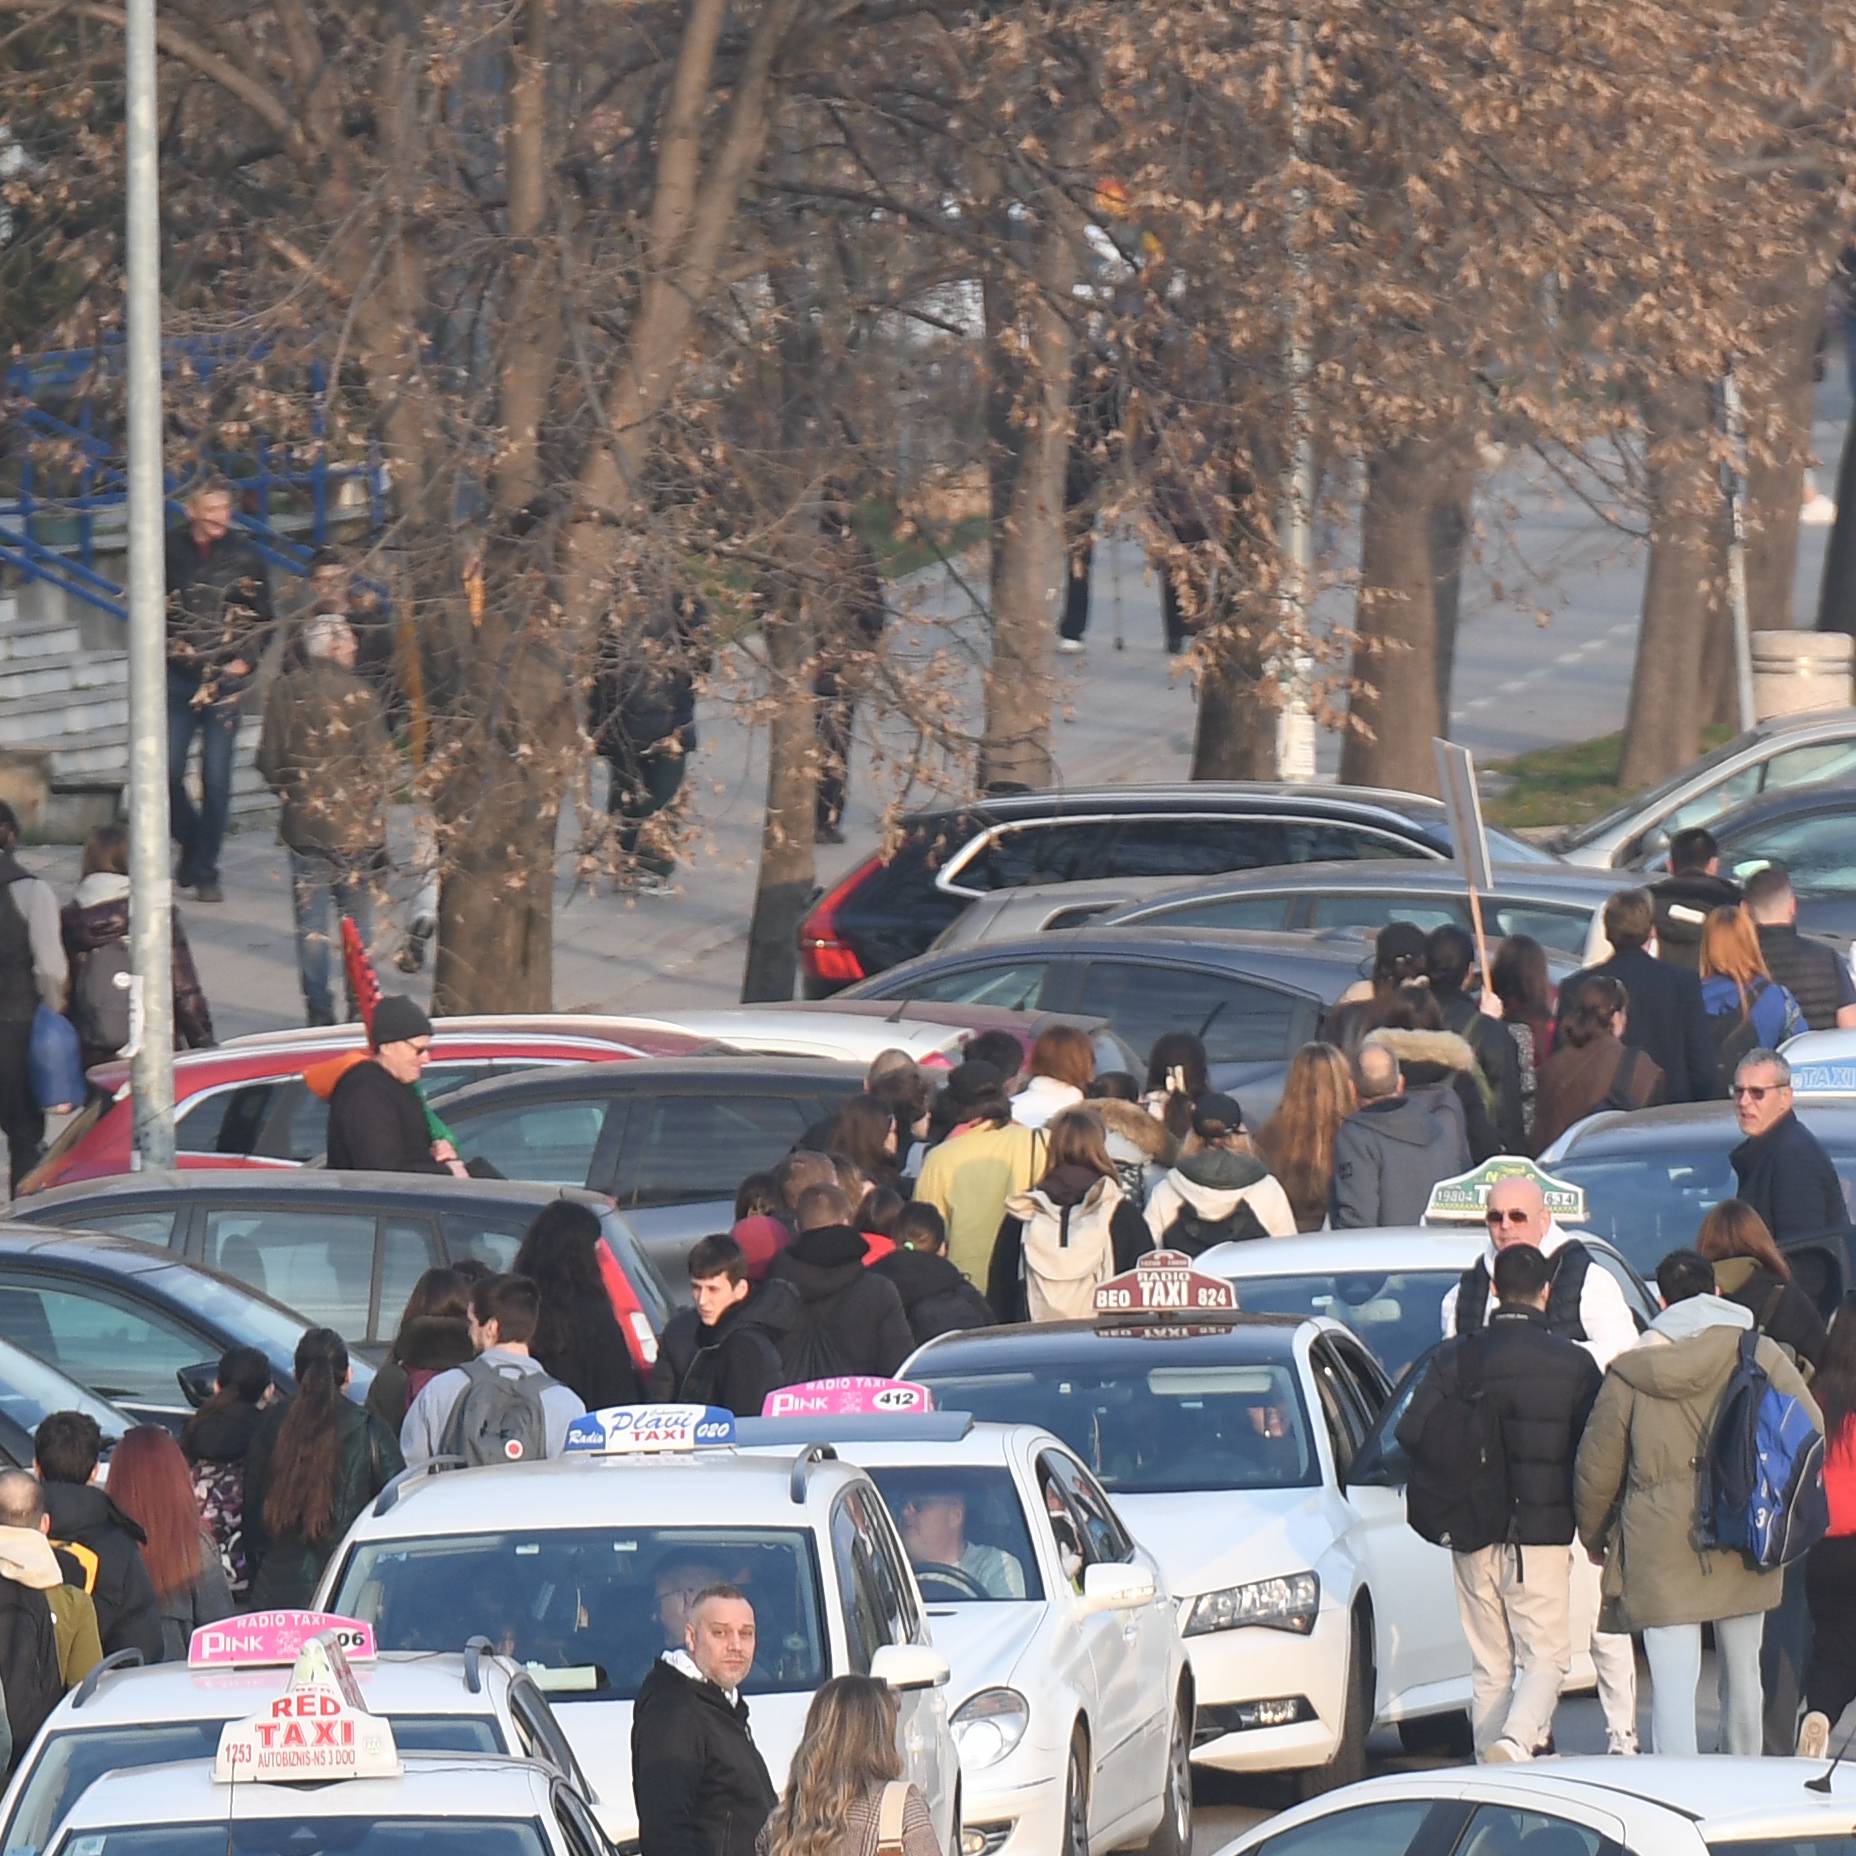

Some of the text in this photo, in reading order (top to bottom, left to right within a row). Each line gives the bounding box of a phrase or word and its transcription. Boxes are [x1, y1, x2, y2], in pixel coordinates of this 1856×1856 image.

[1802, 1066, 1856, 1089] TAXI
[1137, 1271, 1191, 1282] RADIO
[1096, 1281, 1227, 1308] BEO TAXI 824
[806, 1377, 886, 1391] RADIO TAXI
[772, 1392, 914, 1416] PINK 412
[568, 1422, 730, 1444] Radio TAXI 020
[237, 1614, 327, 1629] RADIO TAXI
[201, 1632, 264, 1659] PINK
[272, 1694, 341, 1718] RED
[255, 1719, 355, 1749] TAXI
[225, 1743, 252, 1764] 1253
